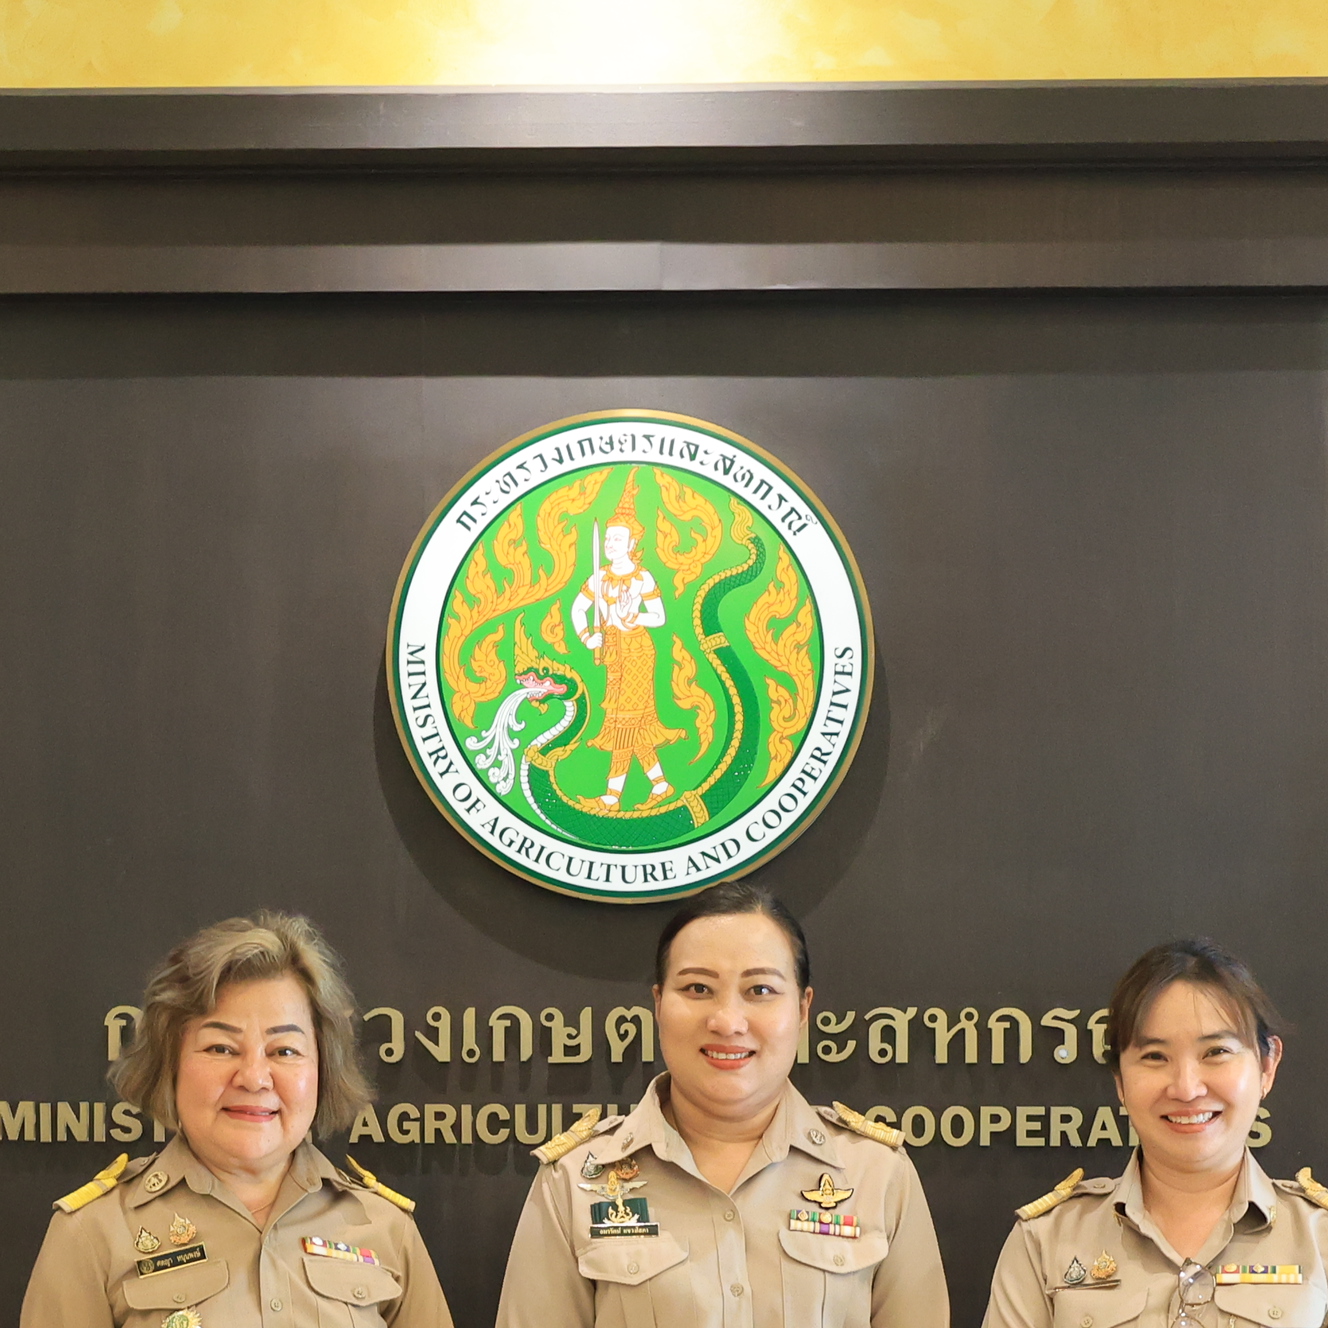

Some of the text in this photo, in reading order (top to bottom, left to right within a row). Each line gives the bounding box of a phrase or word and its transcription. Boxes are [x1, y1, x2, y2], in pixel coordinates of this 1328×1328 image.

[456, 432, 819, 538] กระทรวงเกษตรและสหกรณ์
[406, 642, 855, 885] MINISTRY OF AGRICULTURE AND COOPERATIVES
